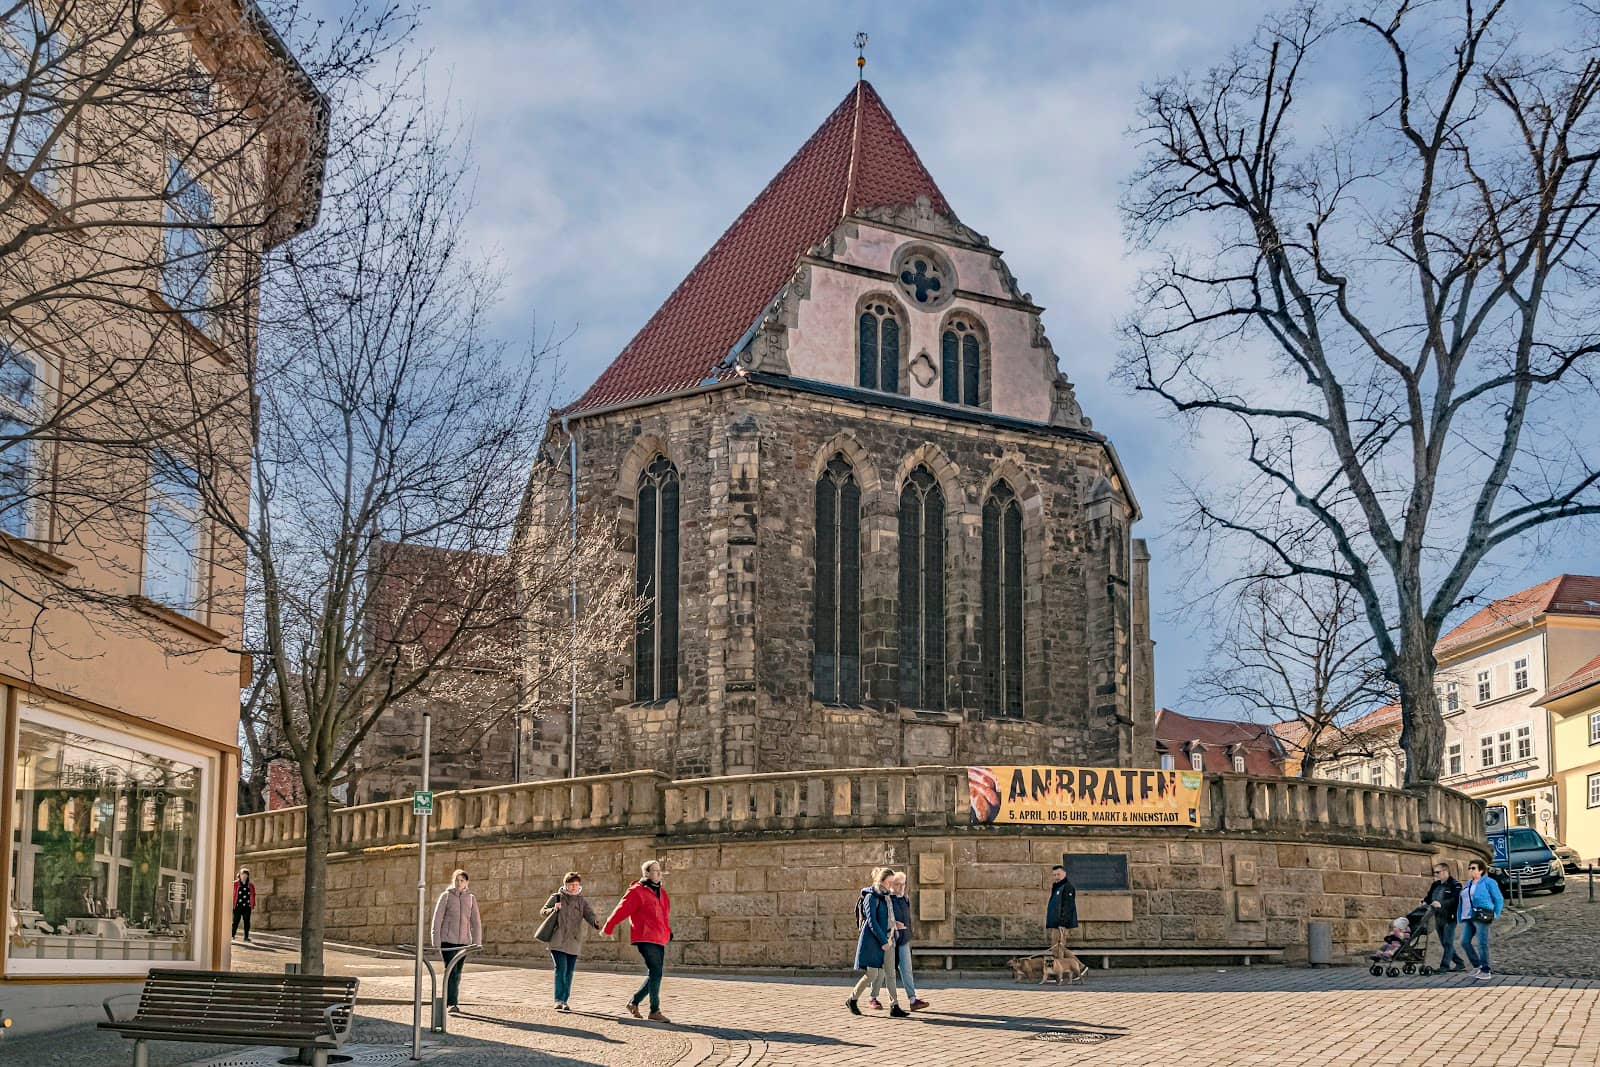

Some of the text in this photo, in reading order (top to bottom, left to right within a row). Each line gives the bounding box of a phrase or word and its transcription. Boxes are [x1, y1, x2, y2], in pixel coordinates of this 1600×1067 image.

[1008, 768, 1176, 805] ANBRATEN
[1009, 810, 1018, 819] 5.
[1070, 811, 1090, 822] UHR,
[1092, 812, 1120, 822] MARKT
[1122, 812, 1128, 821] &
[1130, 812, 1179, 822] INNENSTADT
